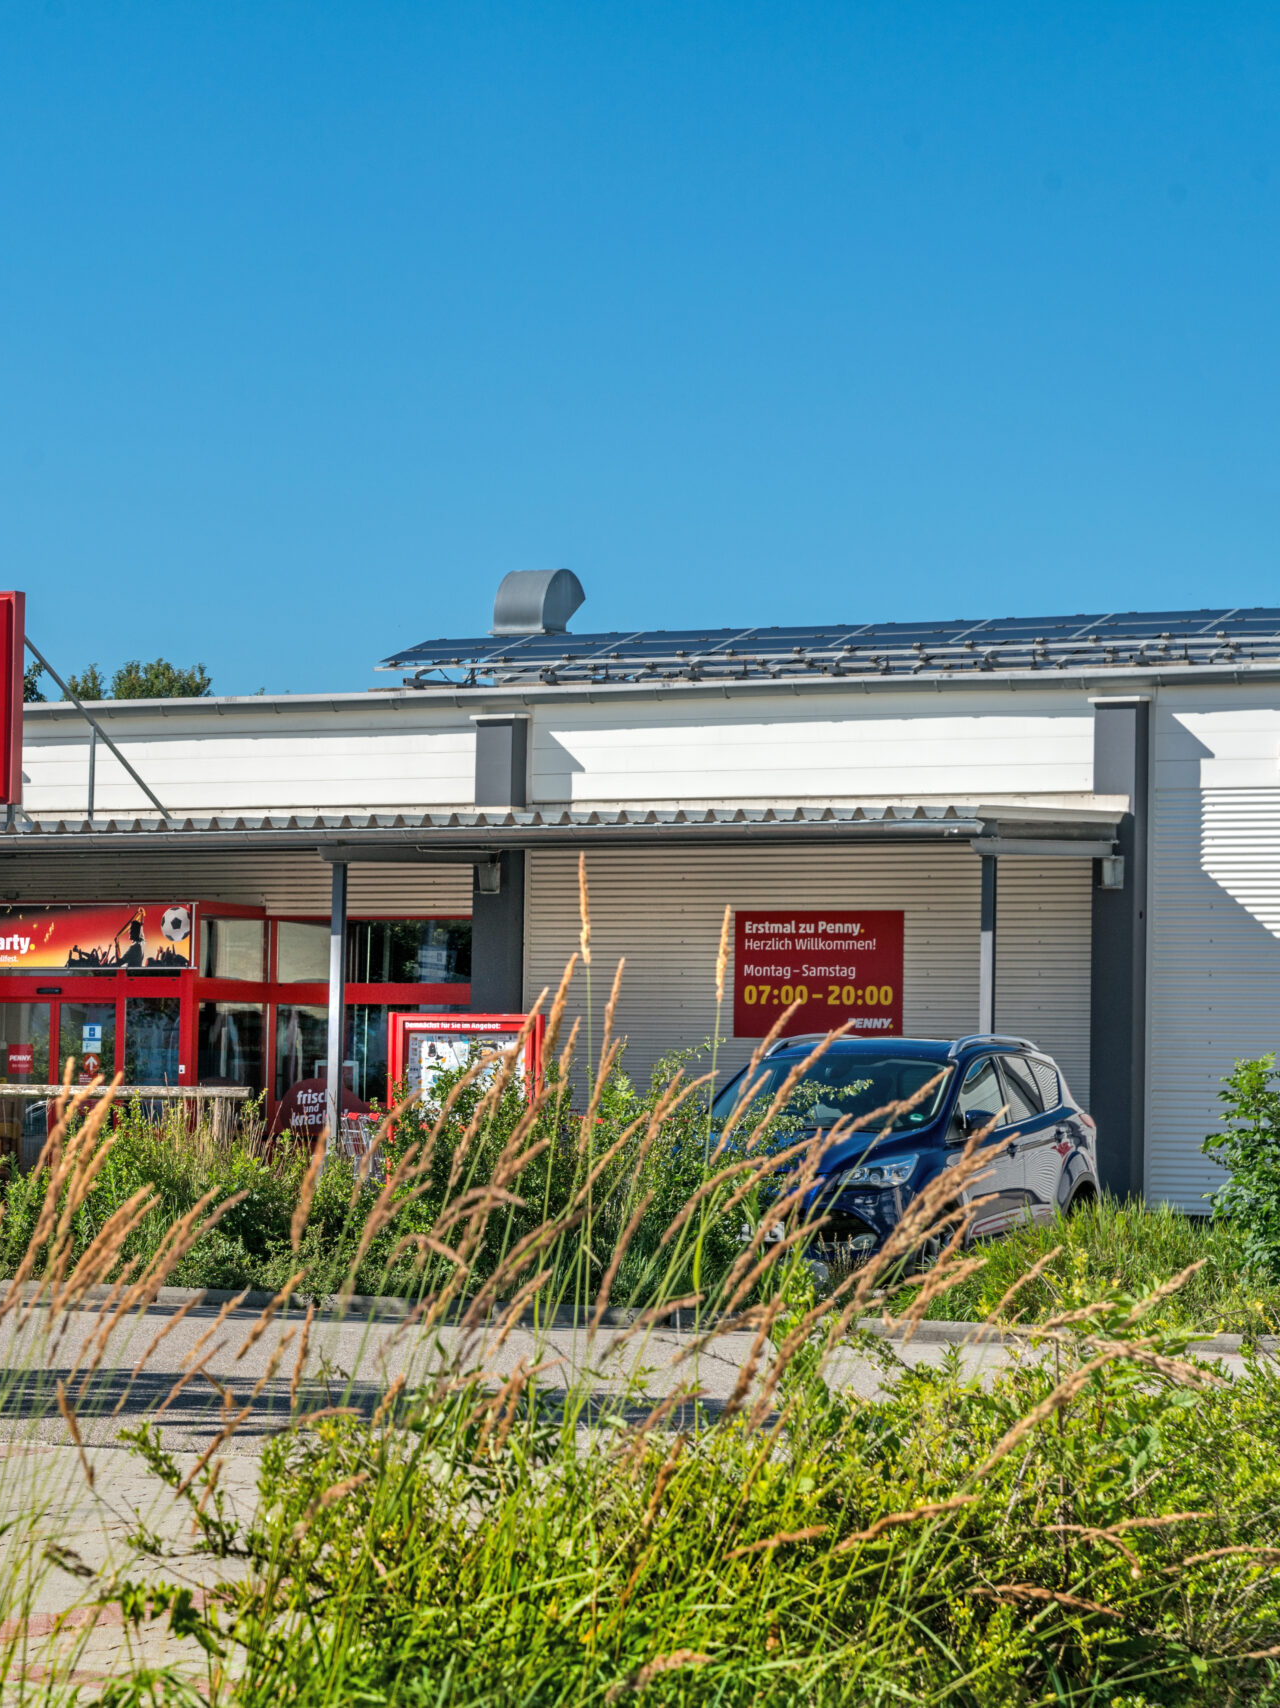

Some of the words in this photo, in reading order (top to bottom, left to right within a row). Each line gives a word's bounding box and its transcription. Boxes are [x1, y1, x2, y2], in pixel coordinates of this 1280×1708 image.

[745, 920, 796, 934] Erstmal
[798, 922, 815, 934] zu
[818, 920, 865, 937] Penny.
[745, 937, 792, 950] Herzlich
[795, 937, 876, 950] Willkommen!
[744, 985, 808, 1005] 07:00
[827, 985, 893, 1005] 20:00
[405, 1021, 440, 1029] Demnächst
[440, 1021, 450, 1029] für
[471, 1022, 501, 1030] Angebot:
[304, 1103, 320, 1113] und
